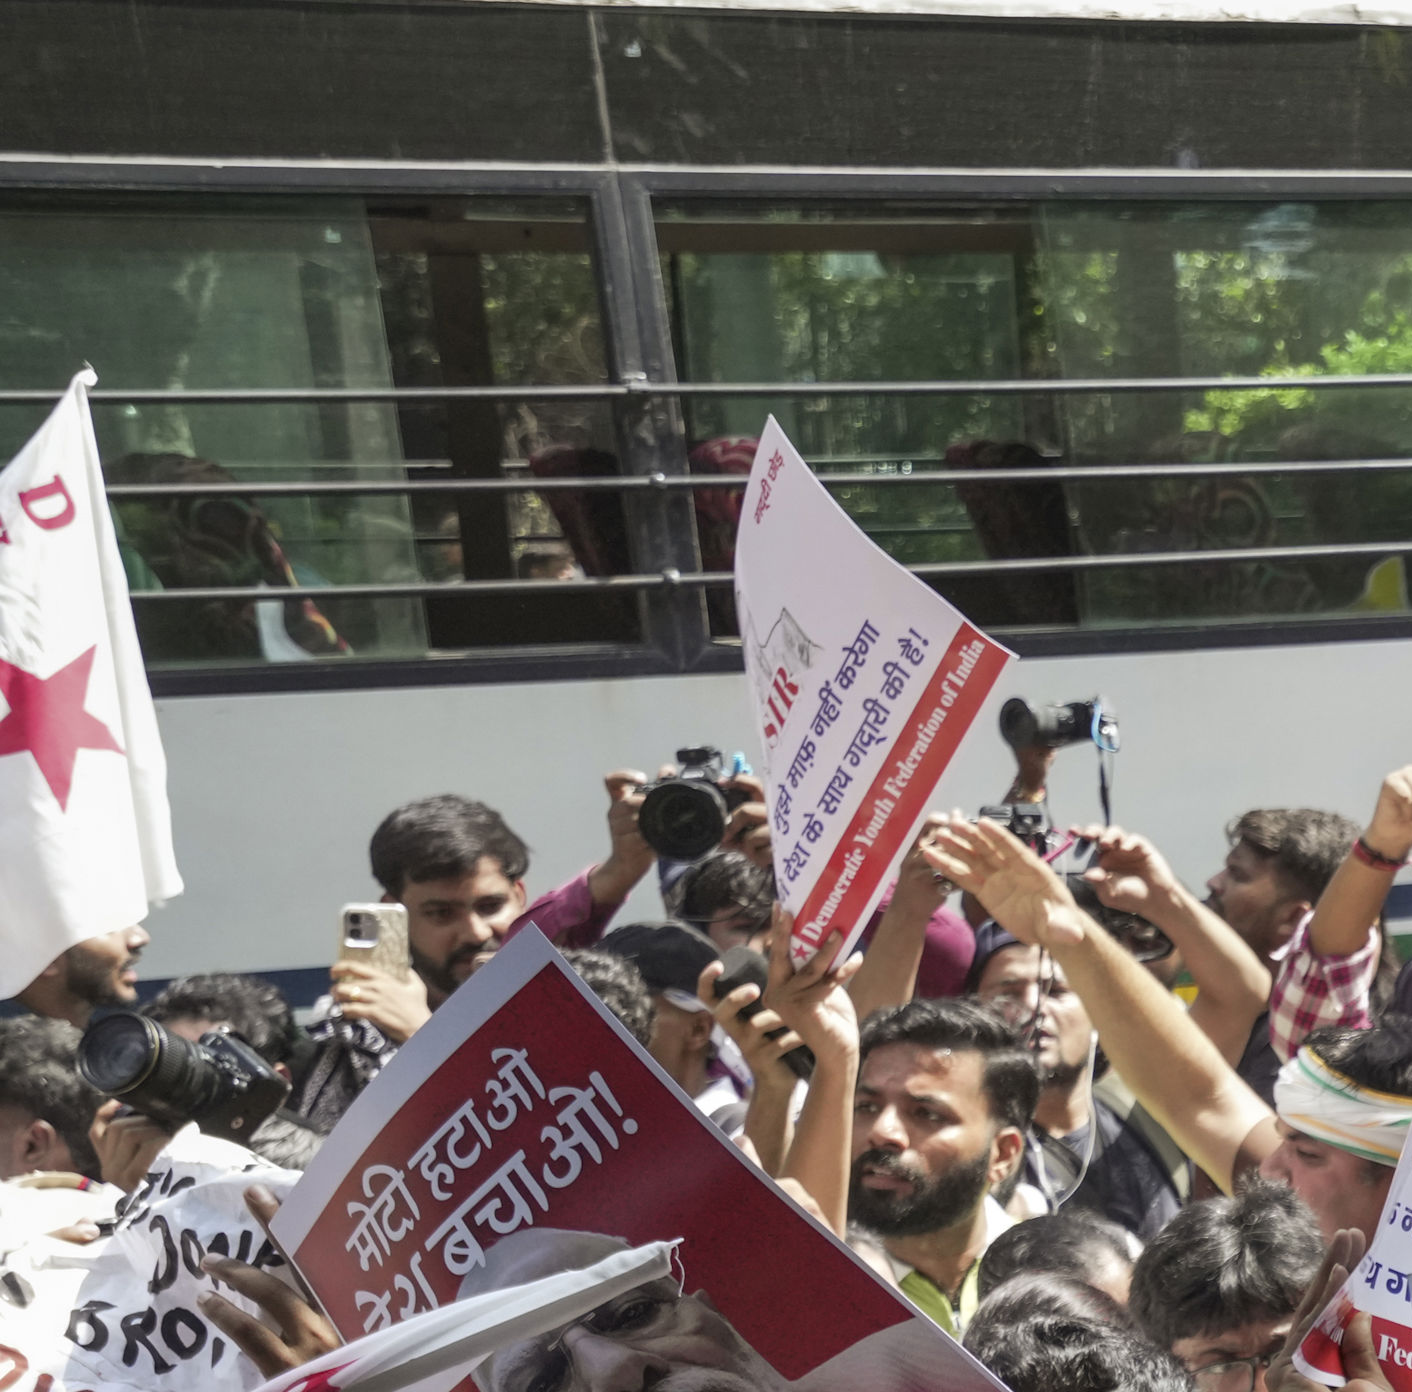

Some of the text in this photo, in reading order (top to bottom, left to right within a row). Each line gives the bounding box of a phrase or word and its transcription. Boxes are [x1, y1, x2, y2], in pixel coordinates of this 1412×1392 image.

[761, 666, 799, 750] SIR
[783, 841, 810, 884] देश
[802, 812, 825, 846] के
[817, 765, 853, 818] साथ
[881, 661, 911, 701] की
[898, 628, 930, 676] है!
[811, 679, 844, 739] नहीं
[835, 619, 882, 693] करेगा
[801, 637, 986, 943] Democratic Youth Federation of India
[345, 1047, 546, 1272] मोदी हटाओ
[424, 1070, 639, 1277] बचाओ!
